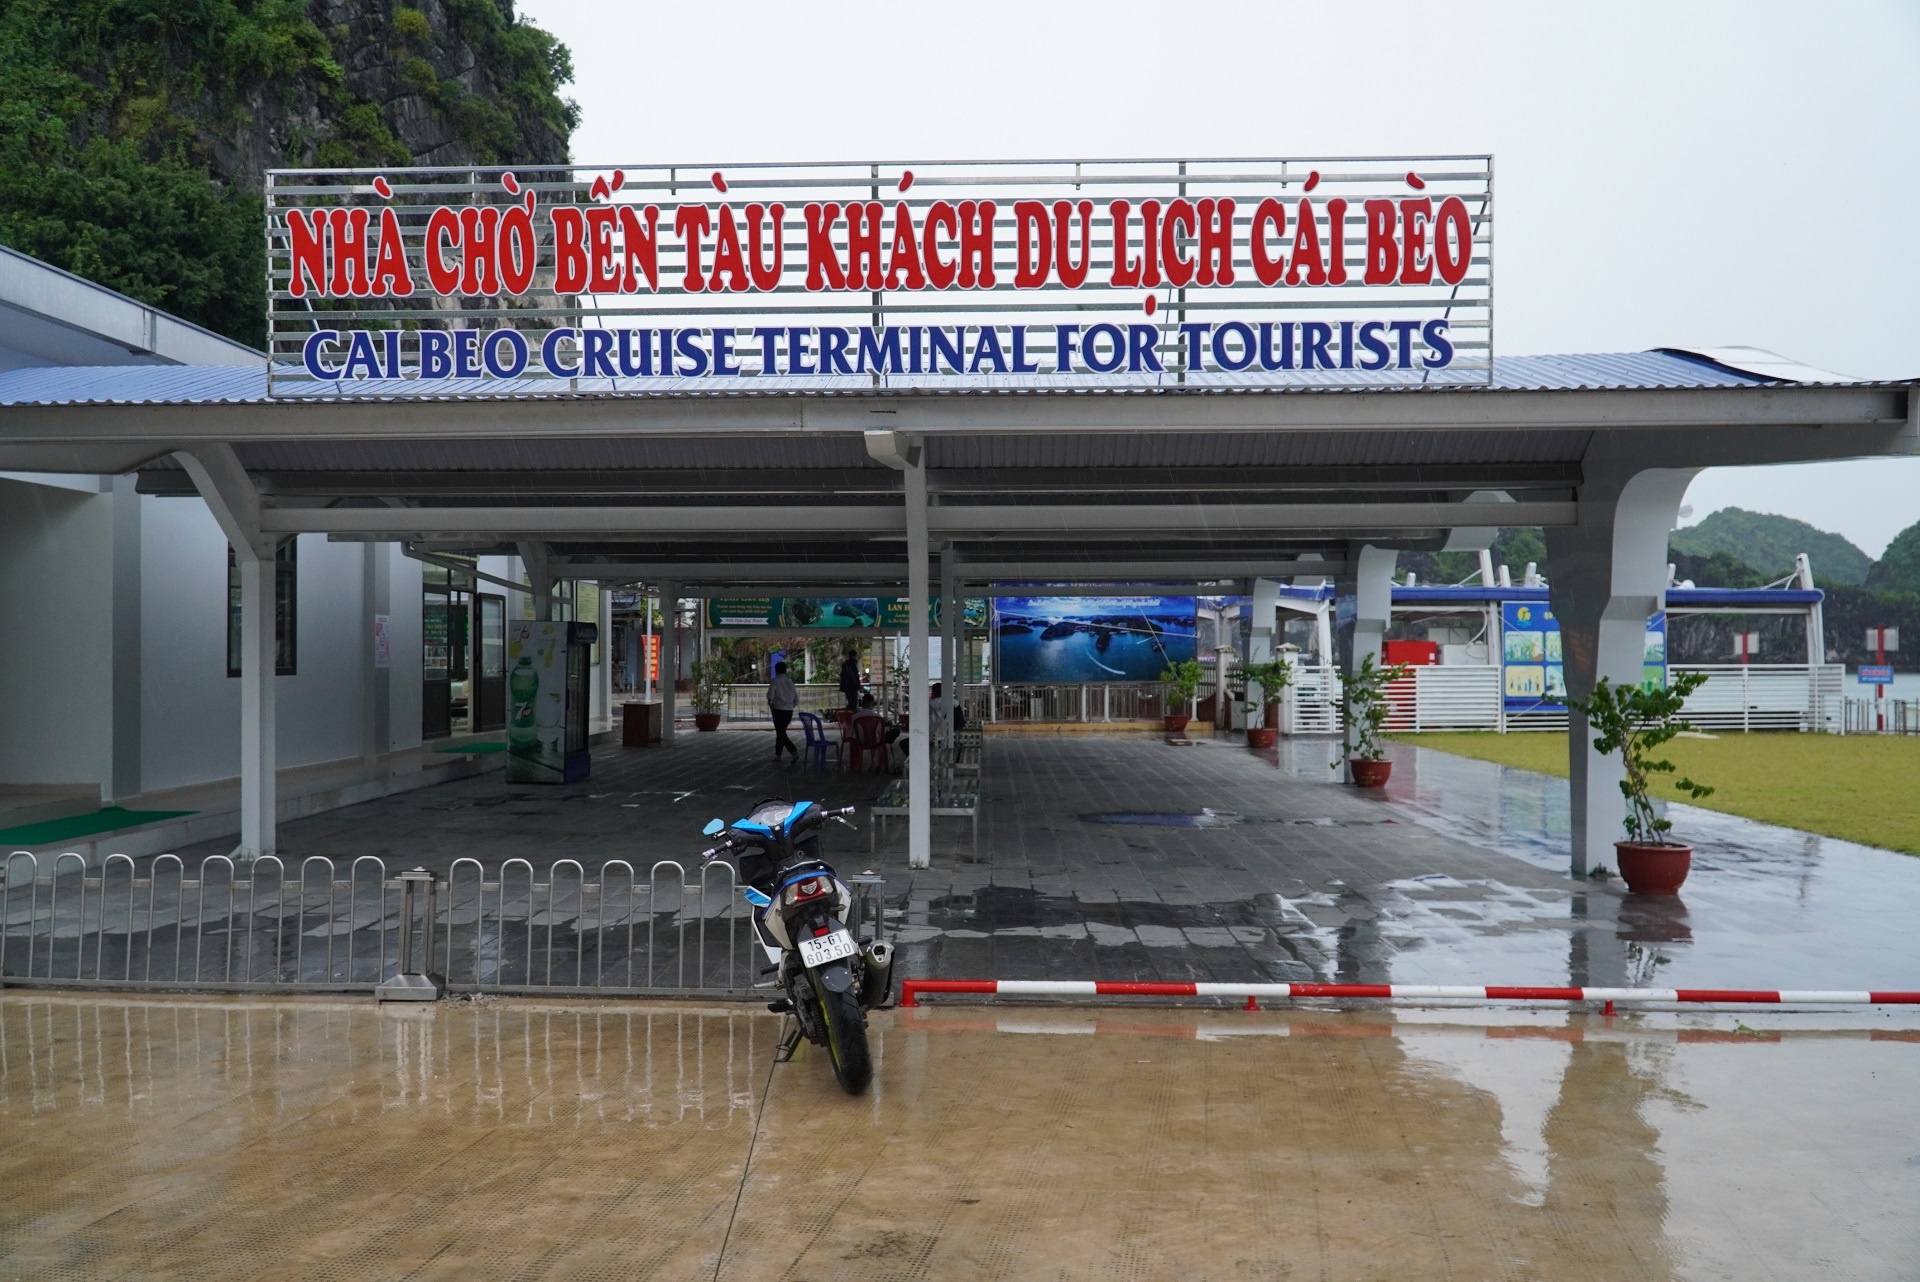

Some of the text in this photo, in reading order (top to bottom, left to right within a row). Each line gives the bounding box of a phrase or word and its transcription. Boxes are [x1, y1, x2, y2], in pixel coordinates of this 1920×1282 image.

[285, 169, 1474, 317] NHÀ CHỜ BẾN TÀU KHÁCH DU LỊCH CÁI BÈO
[302, 318, 1455, 381] CAI BEO CRUISE TERMINAL FOR TOURISTS
[807, 943, 851, 965] 603.50
[808, 933, 842, 951] 15-G1
